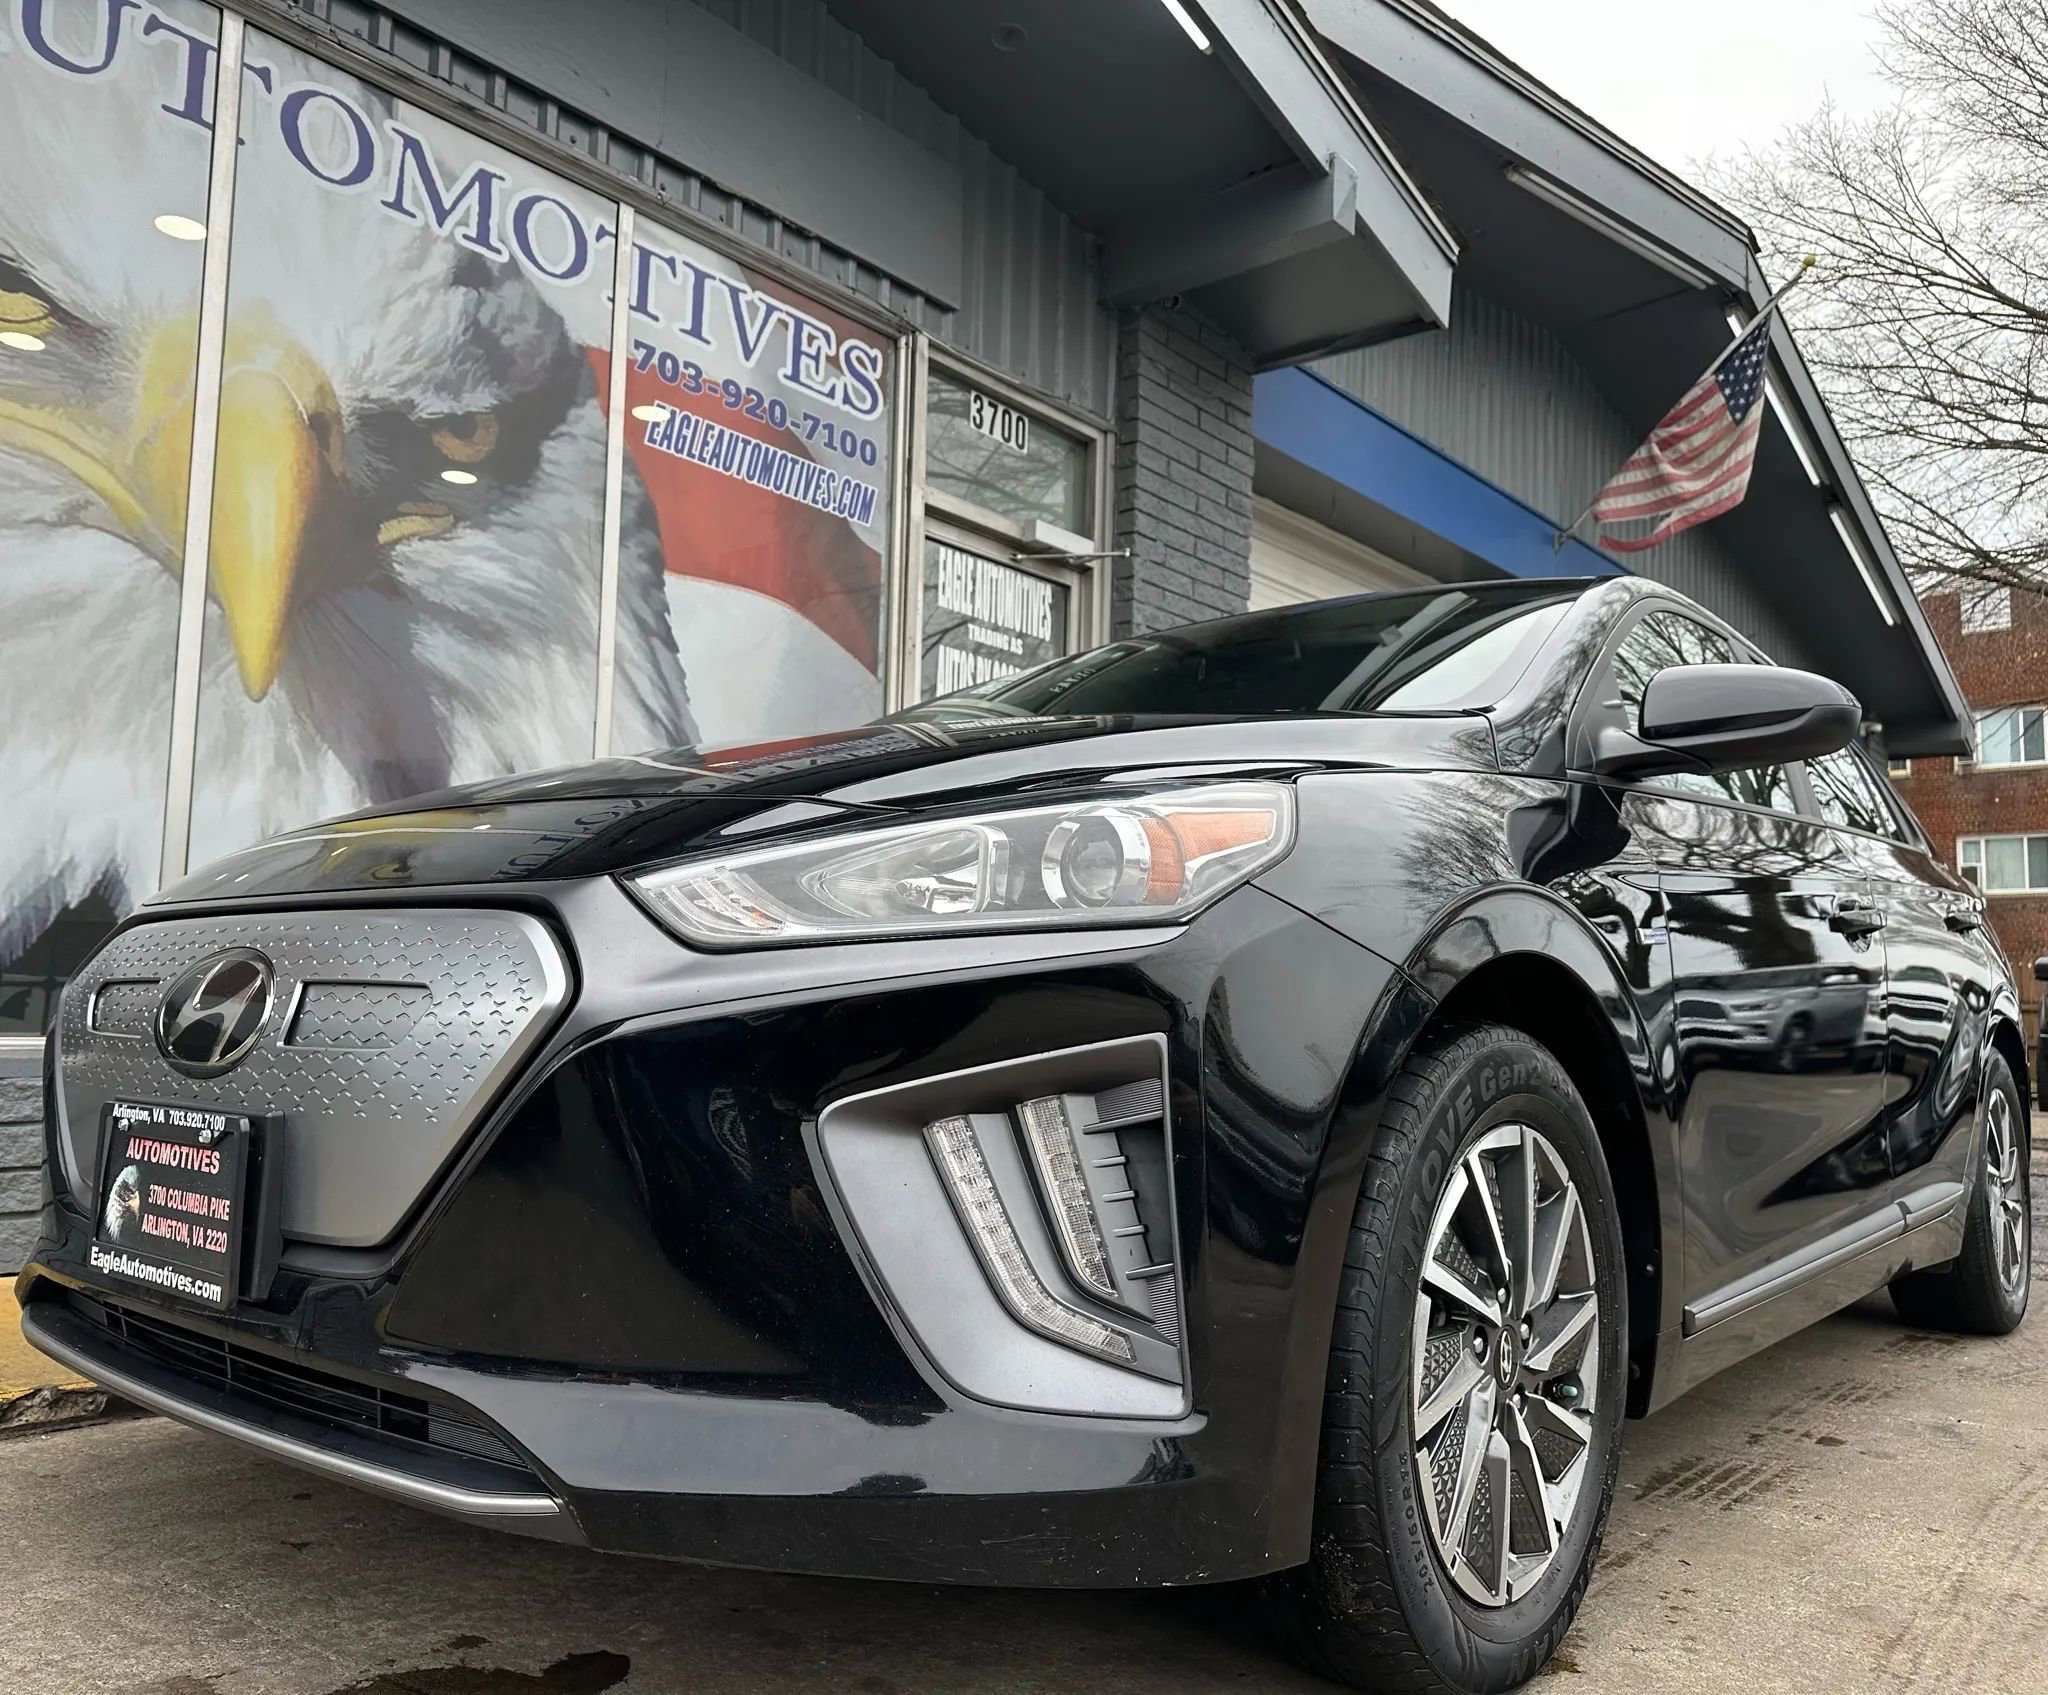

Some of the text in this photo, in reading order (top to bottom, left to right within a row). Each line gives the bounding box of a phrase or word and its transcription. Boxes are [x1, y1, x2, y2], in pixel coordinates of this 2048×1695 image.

[633, 338, 878, 467] 703-920-7100
[972, 393, 1026, 450] 3700
[645, 401, 876, 525] EAGLEAUTOMOTIVES.COM
[937, 546, 1053, 643] EAGLE AUTOMOTIVES
[967, 622, 1024, 656] TRADING AS
[112, 1103, 226, 1132] Arlington, VA 703.920.7100
[125, 1137, 221, 1175] AUTOMOTIVES
[148, 1184, 231, 1221] 3700 COLUMBIA PIKE
[141, 1213, 228, 1254] ARLINGTON, VA 2220
[90, 1246, 223, 1303] EagleAutomotives.com
